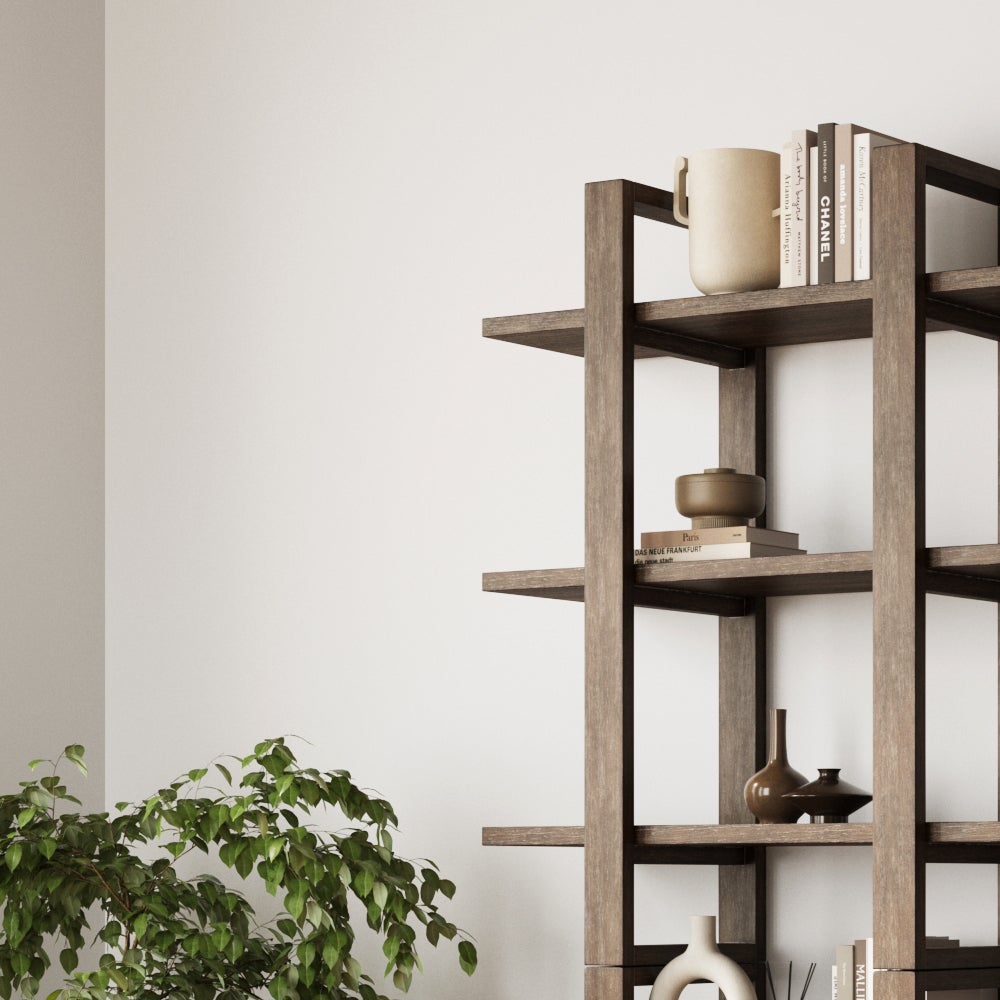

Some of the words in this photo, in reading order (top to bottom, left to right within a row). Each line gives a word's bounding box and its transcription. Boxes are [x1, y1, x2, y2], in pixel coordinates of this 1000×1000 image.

[783, 214, 791, 264] Huffington
[820, 196, 830, 262] CHANEL
[666, 546, 702, 554] FRANKFURT
[682, 533, 699, 542] Paris
